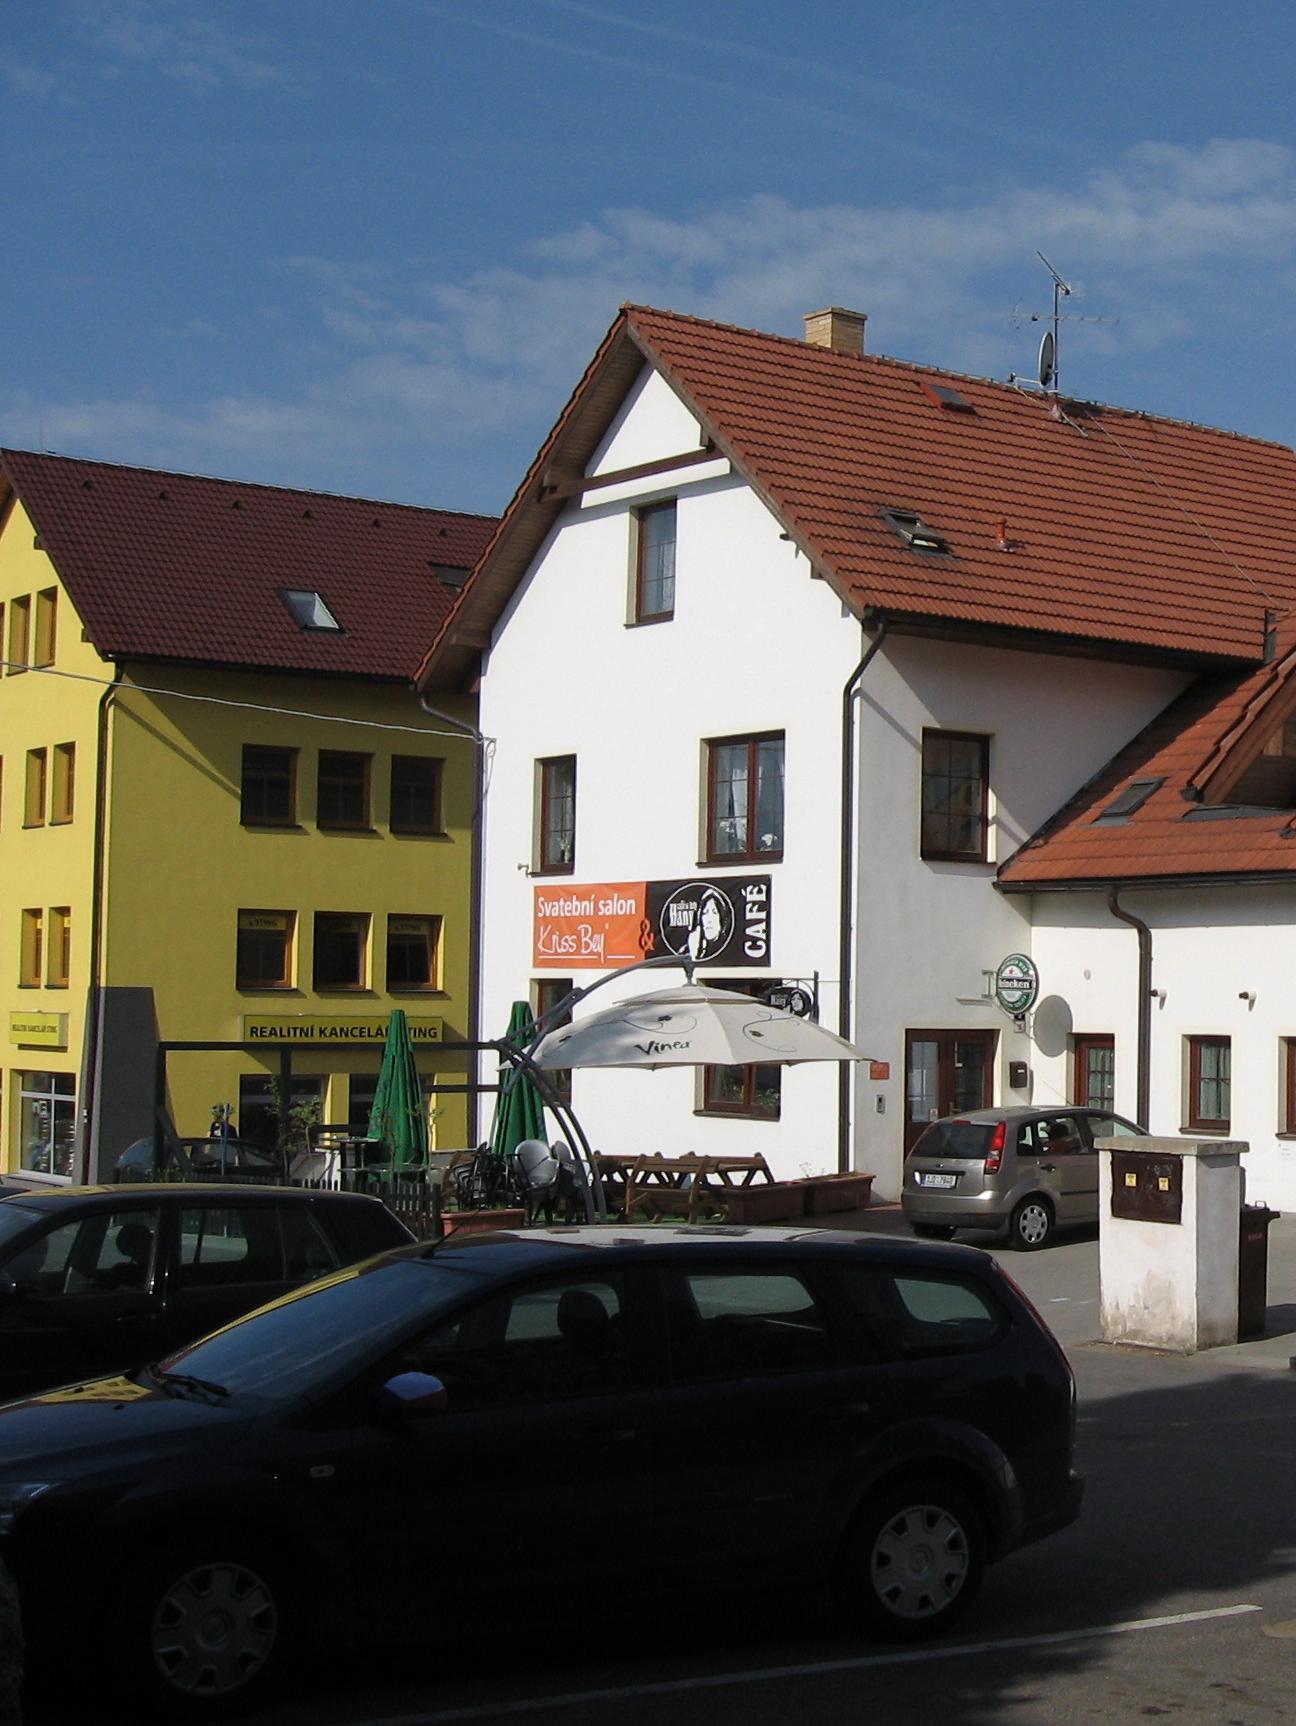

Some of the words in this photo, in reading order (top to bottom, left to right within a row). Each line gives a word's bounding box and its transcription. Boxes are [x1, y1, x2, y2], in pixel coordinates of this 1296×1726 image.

[537, 894, 595, 917] Svatební
[598, 893, 635, 915] salon
[741, 884, 767, 958] CAFÉ
[639, 919, 656, 951] &
[250, 1024, 314, 1038] REALITNÍ
[319, 1023, 389, 1038] KANCELÁ
[411, 1027, 437, 1038] TING
[634, 1040, 692, 1055] Vinea
